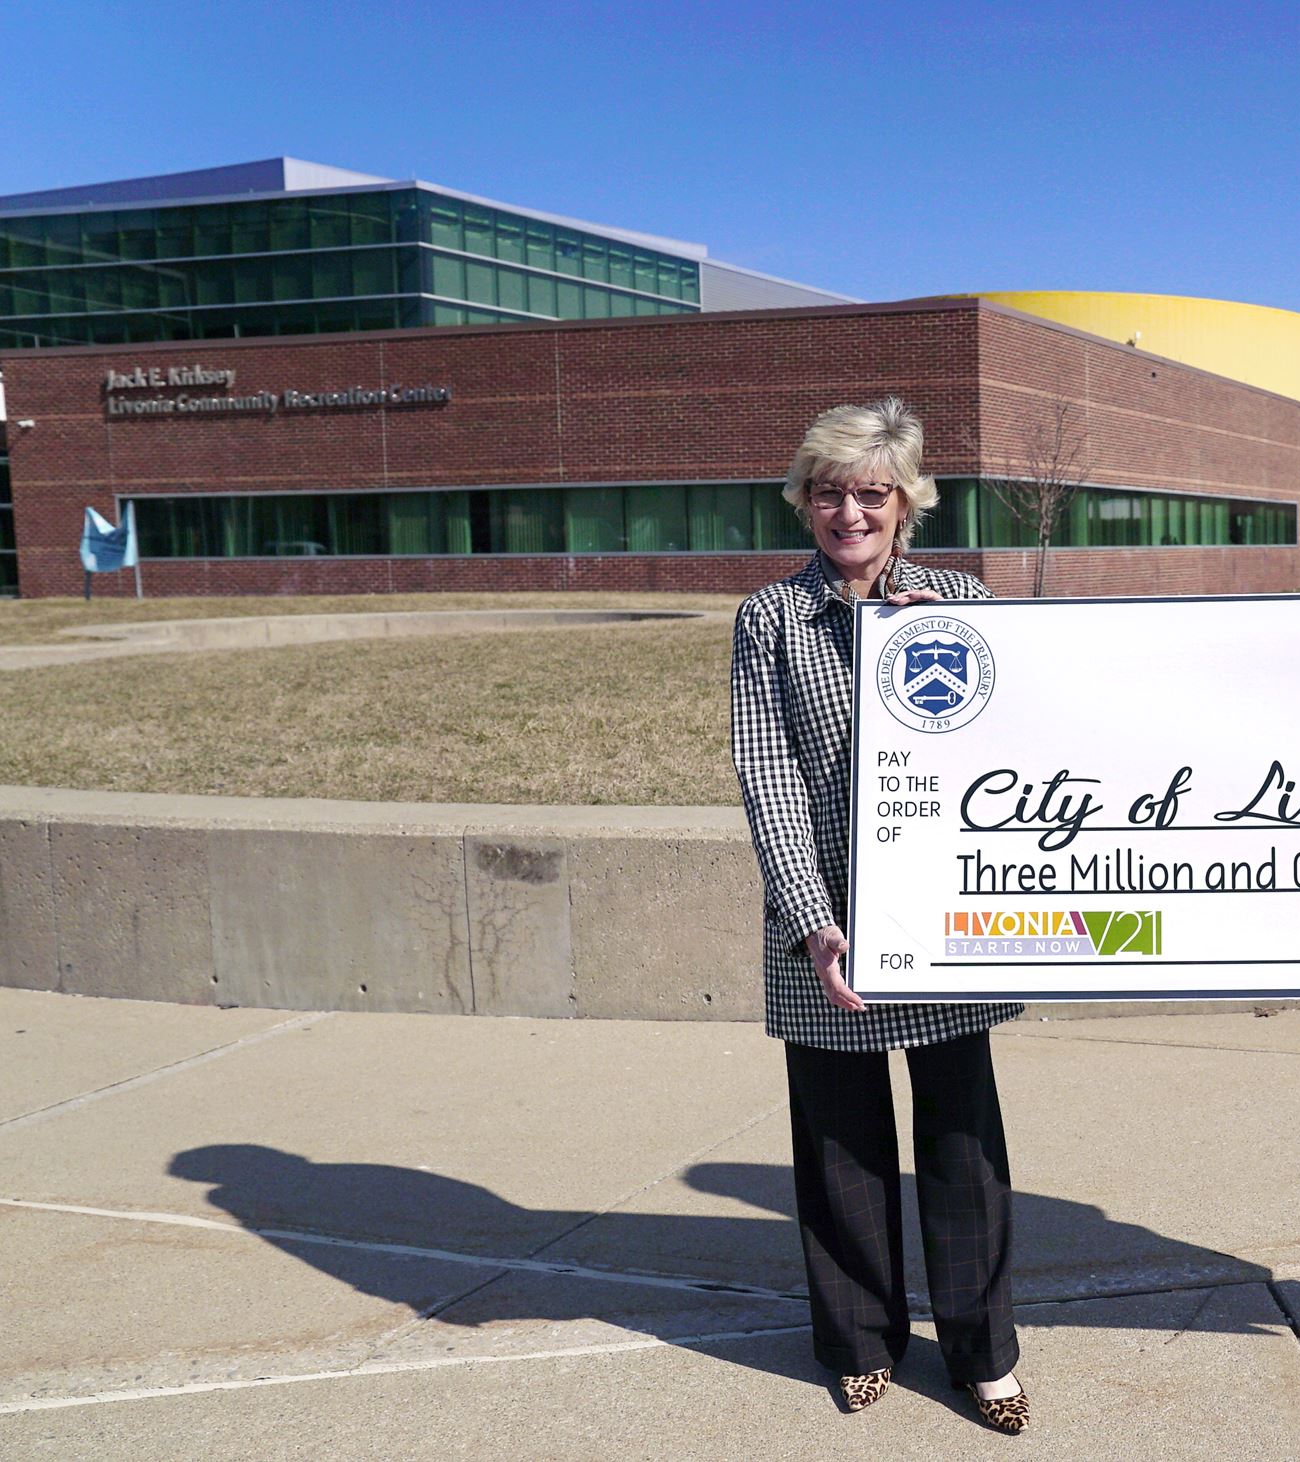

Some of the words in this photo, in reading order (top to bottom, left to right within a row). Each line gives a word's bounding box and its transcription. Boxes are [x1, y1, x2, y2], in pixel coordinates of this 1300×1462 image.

[106, 366, 148, 391] Jack
[168, 364, 236, 388] Kirksey
[108, 395, 175, 414] Livonia
[177, 391, 279, 414] Community
[284, 385, 387, 407] Recreation
[389, 383, 452, 402] Center
[937, 620, 953, 630] OF
[954, 623, 976, 644] THE
[881, 620, 935, 675] DEPARTMENT
[972, 639, 992, 700] TREASURY
[881, 676, 894, 701] THE
[921, 719, 951, 730] 1789
[877, 751, 912, 768] PAY
[878, 776, 902, 792] TO
[906, 776, 939, 792] THE
[877, 801, 941, 818] ORDER
[960, 768, 1104, 851] City
[1128, 766, 1193, 829] of
[877, 827, 901, 843] OF
[957, 849, 1057, 892] Three
[1070, 848, 1194, 891] Million
[1205, 847, 1277, 890] and
[949, 912, 1078, 936] LIVONIA
[948, 941, 1024, 953] STARTS
[1035, 941, 1081, 953] NOW
[880, 954, 914, 970] FOR
